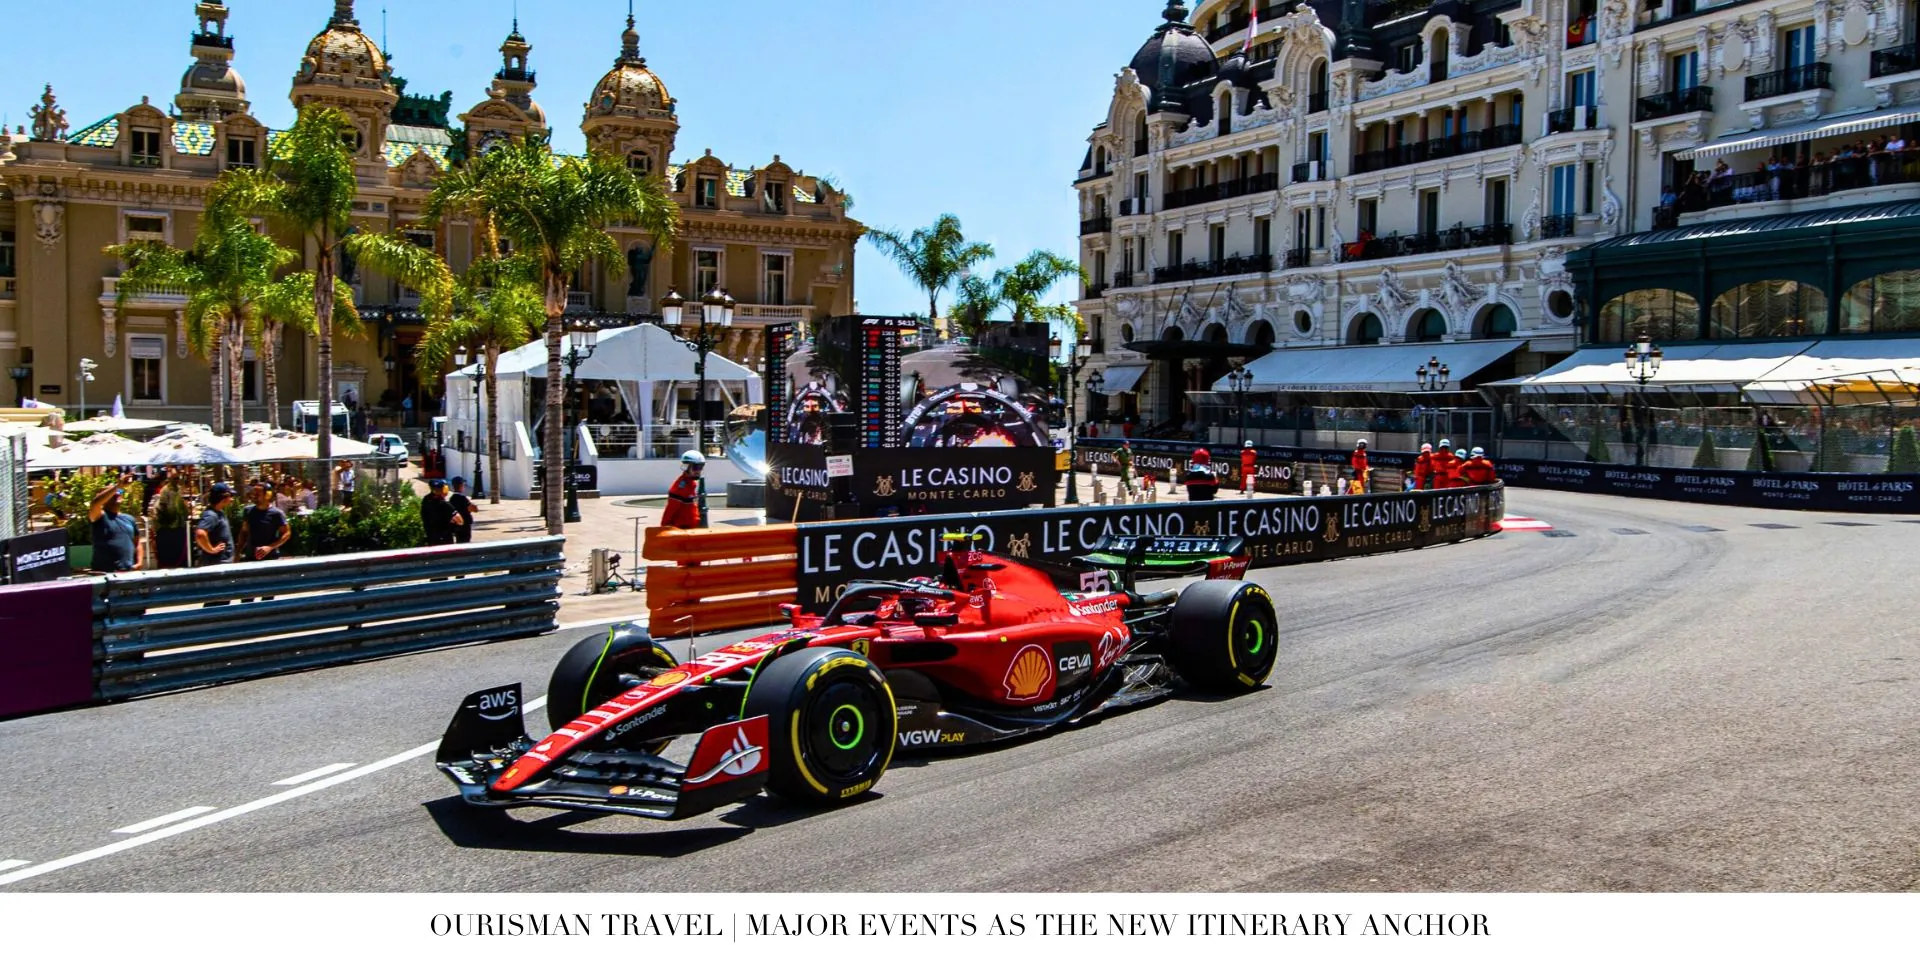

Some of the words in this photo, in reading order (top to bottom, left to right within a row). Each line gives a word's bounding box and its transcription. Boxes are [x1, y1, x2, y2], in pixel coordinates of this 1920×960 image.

[1142, 456, 1174, 469] CASINO
[1568, 468, 1591, 477] PARIS
[782, 467, 792, 484] LE
[792, 468, 830, 488] CASINO
[902, 468, 923, 487] LE
[928, 466, 1012, 486] CASINO
[1637, 472, 1660, 482] PARIS
[1710, 476, 1735, 486] PARIS
[1791, 480, 1819, 491] PARIS
[1881, 482, 1913, 492] PARIS
[1344, 503, 1358, 528] LE
[1362, 500, 1416, 526] CASINO
[1432, 496, 1444, 519] LE
[1218, 510, 1238, 536] LE
[1242, 504, 1320, 535] CASINO
[1043, 519, 1072, 553] LE
[1078, 512, 1185, 550] CASINO
[16, 546, 66, 566] MONTE-CARLO
[804, 534, 842, 574] LE
[1224, 561, 1248, 570] V-Power
[1080, 570, 1110, 596] 55
[1076, 599, 1118, 616] Santander
[480, 690, 516, 710] aws
[616, 704, 668, 736] Santander
[898, 729, 941, 746] VGW
[941, 732, 965, 742] PLAY
